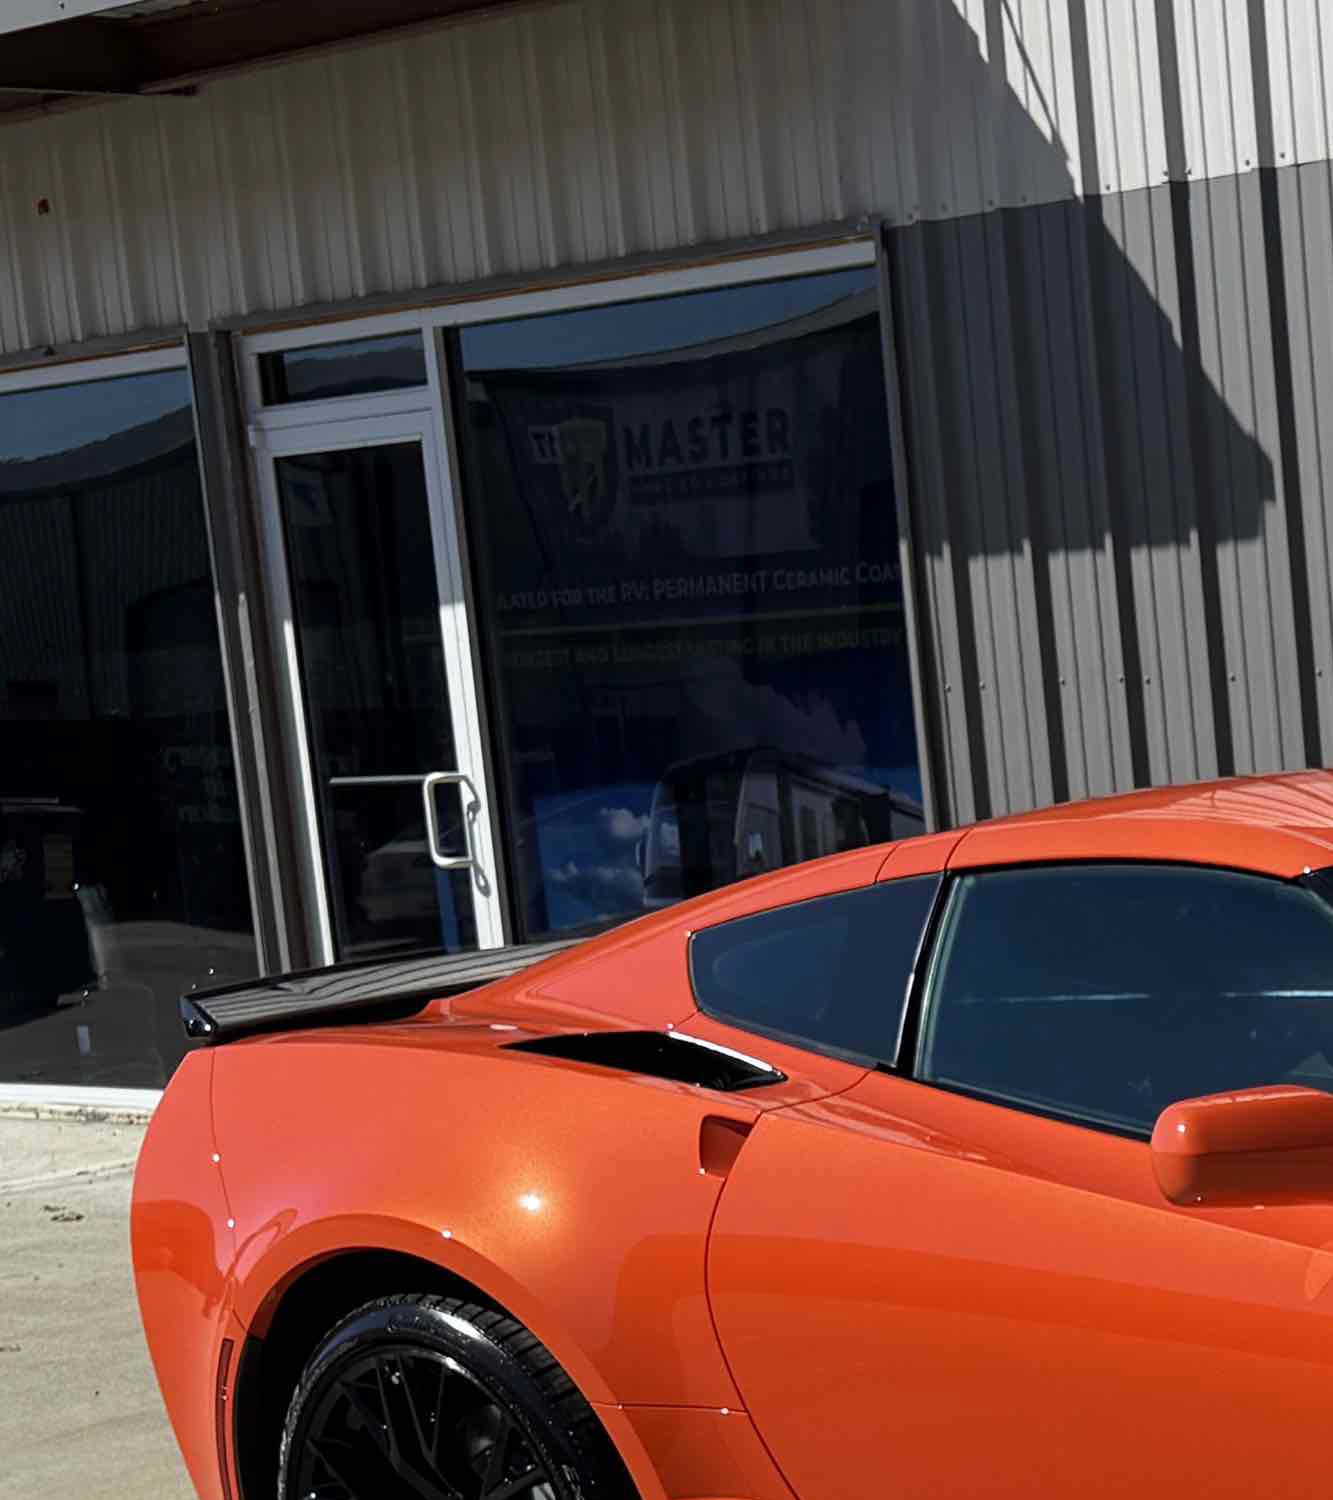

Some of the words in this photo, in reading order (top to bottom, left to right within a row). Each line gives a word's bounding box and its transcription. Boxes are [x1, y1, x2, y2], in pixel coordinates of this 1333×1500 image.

[620, 407, 793, 469] MASTER
[652, 570, 769, 602] PERMANENT
[772, 566, 853, 593] CERAMIC
